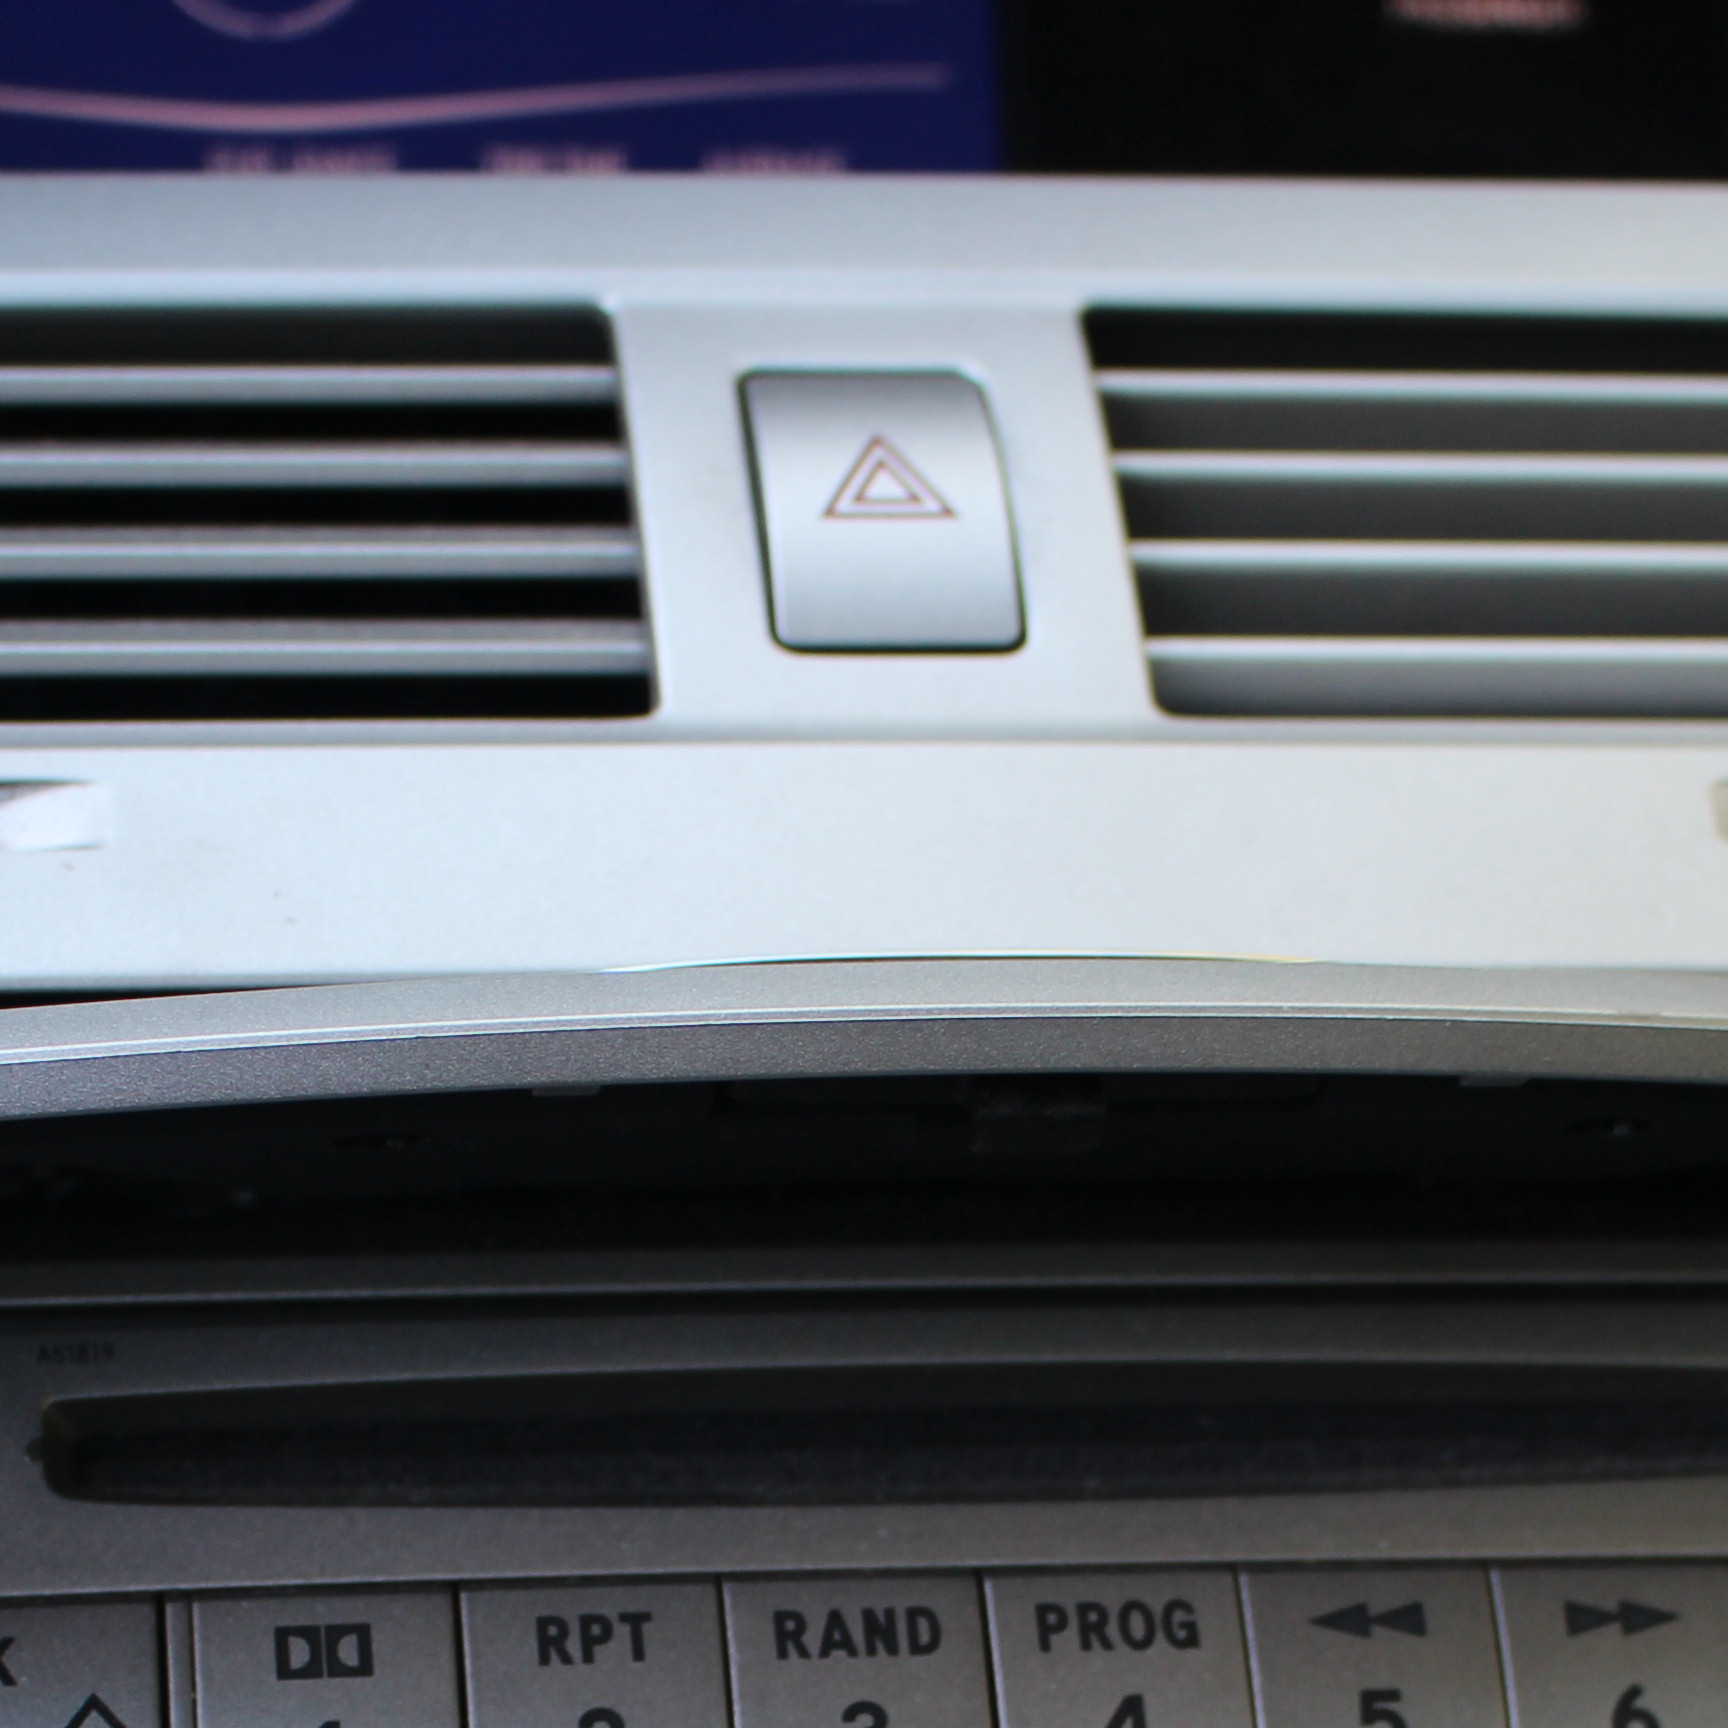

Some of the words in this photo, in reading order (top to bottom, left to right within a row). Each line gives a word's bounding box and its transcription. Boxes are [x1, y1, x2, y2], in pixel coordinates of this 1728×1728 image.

[536, 1611, 652, 1666] RPT
[772, 1606, 941, 1661] RAND
[1034, 1599, 1201, 1652] PROG
